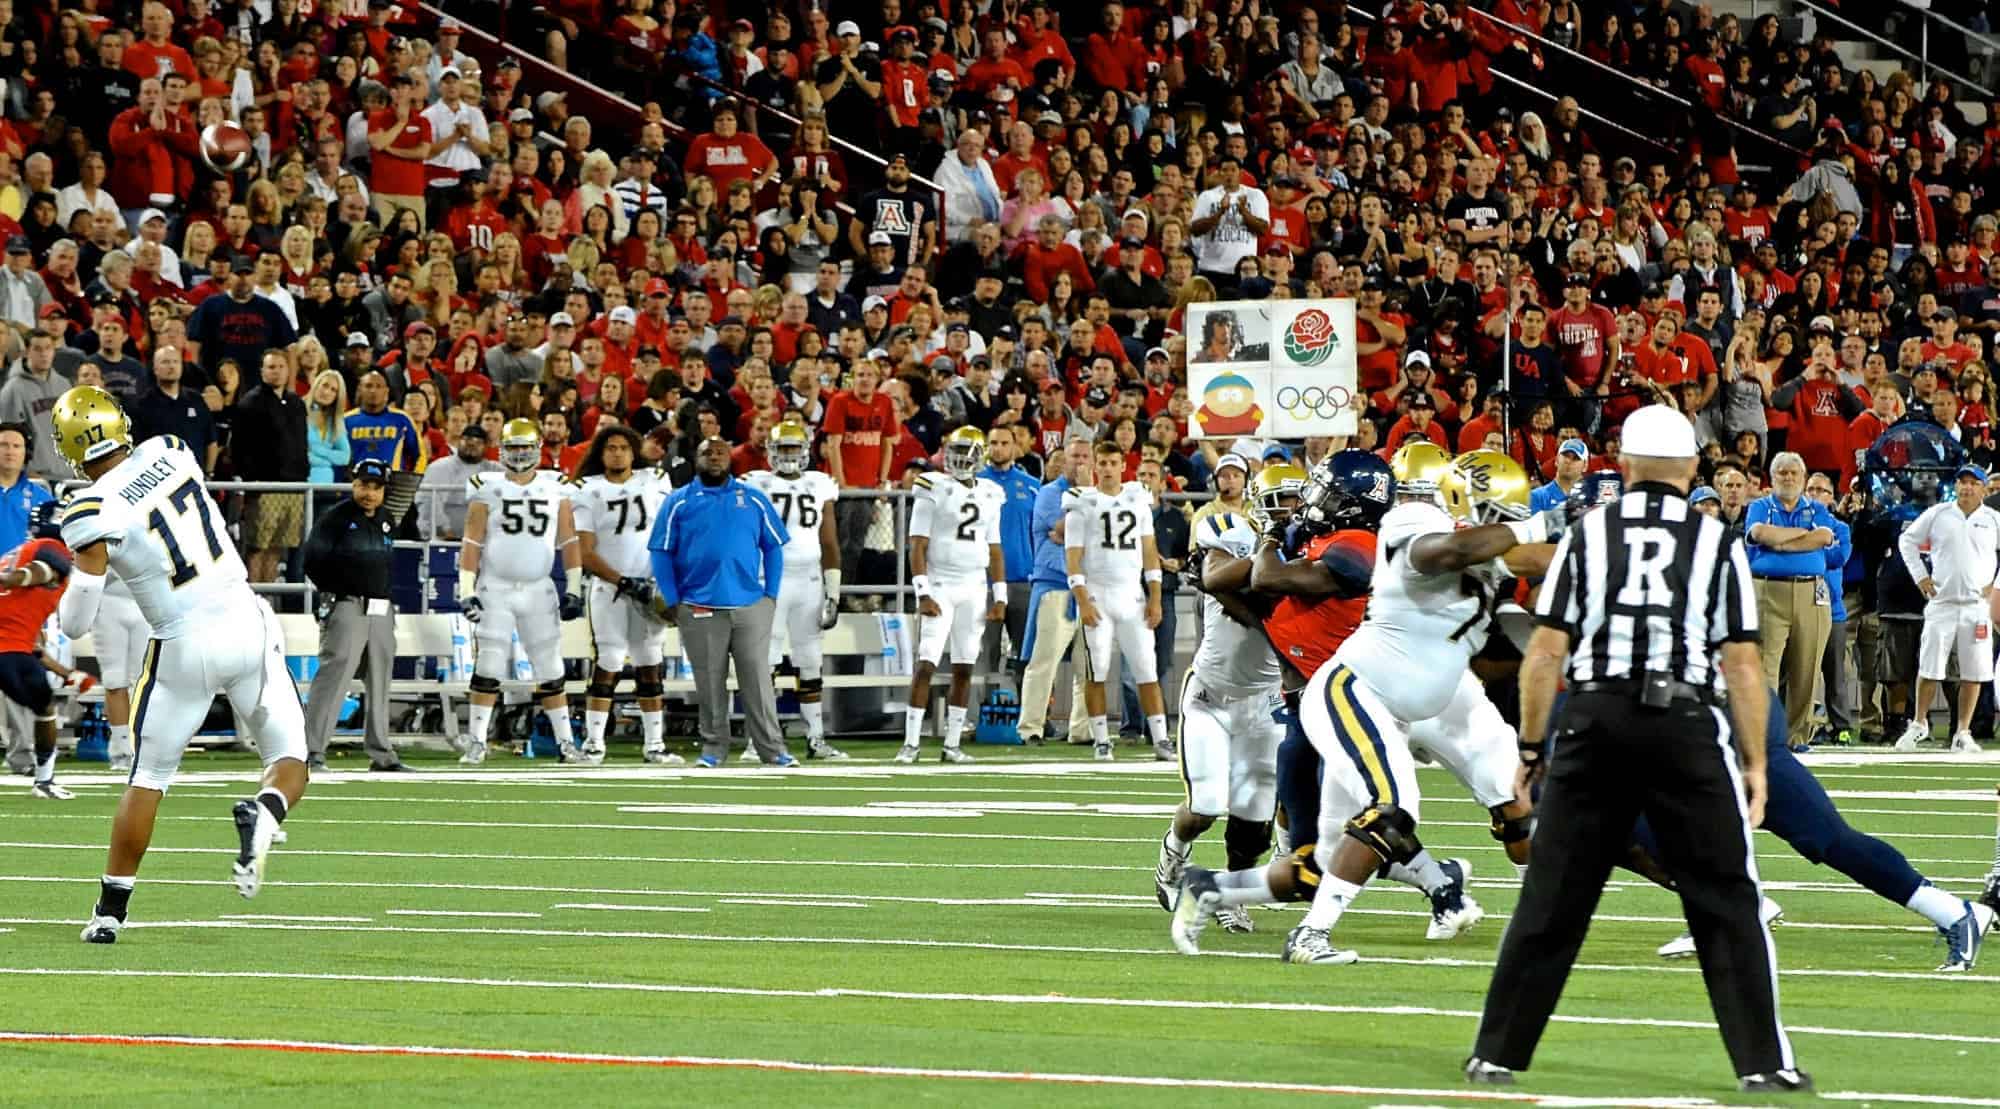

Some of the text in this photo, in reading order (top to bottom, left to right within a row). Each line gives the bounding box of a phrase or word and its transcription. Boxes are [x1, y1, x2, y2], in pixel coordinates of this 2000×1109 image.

[873, 199, 911, 236] A
[467, 224, 493, 253] 10
[1515, 353, 1541, 379] UA
[83, 424, 105, 446] 17
[352, 426, 397, 440] UCLA
[118, 456, 177, 506] HUNDLEY
[1368, 471, 1390, 503] A
[501, 499, 549, 536] 55
[607, 495, 647, 535] 71
[771, 493, 817, 528] 76
[956, 503, 980, 541] 2
[149, 477, 224, 588] 17
[1100, 510, 1137, 549] 12
[1617, 527, 1677, 608] R
